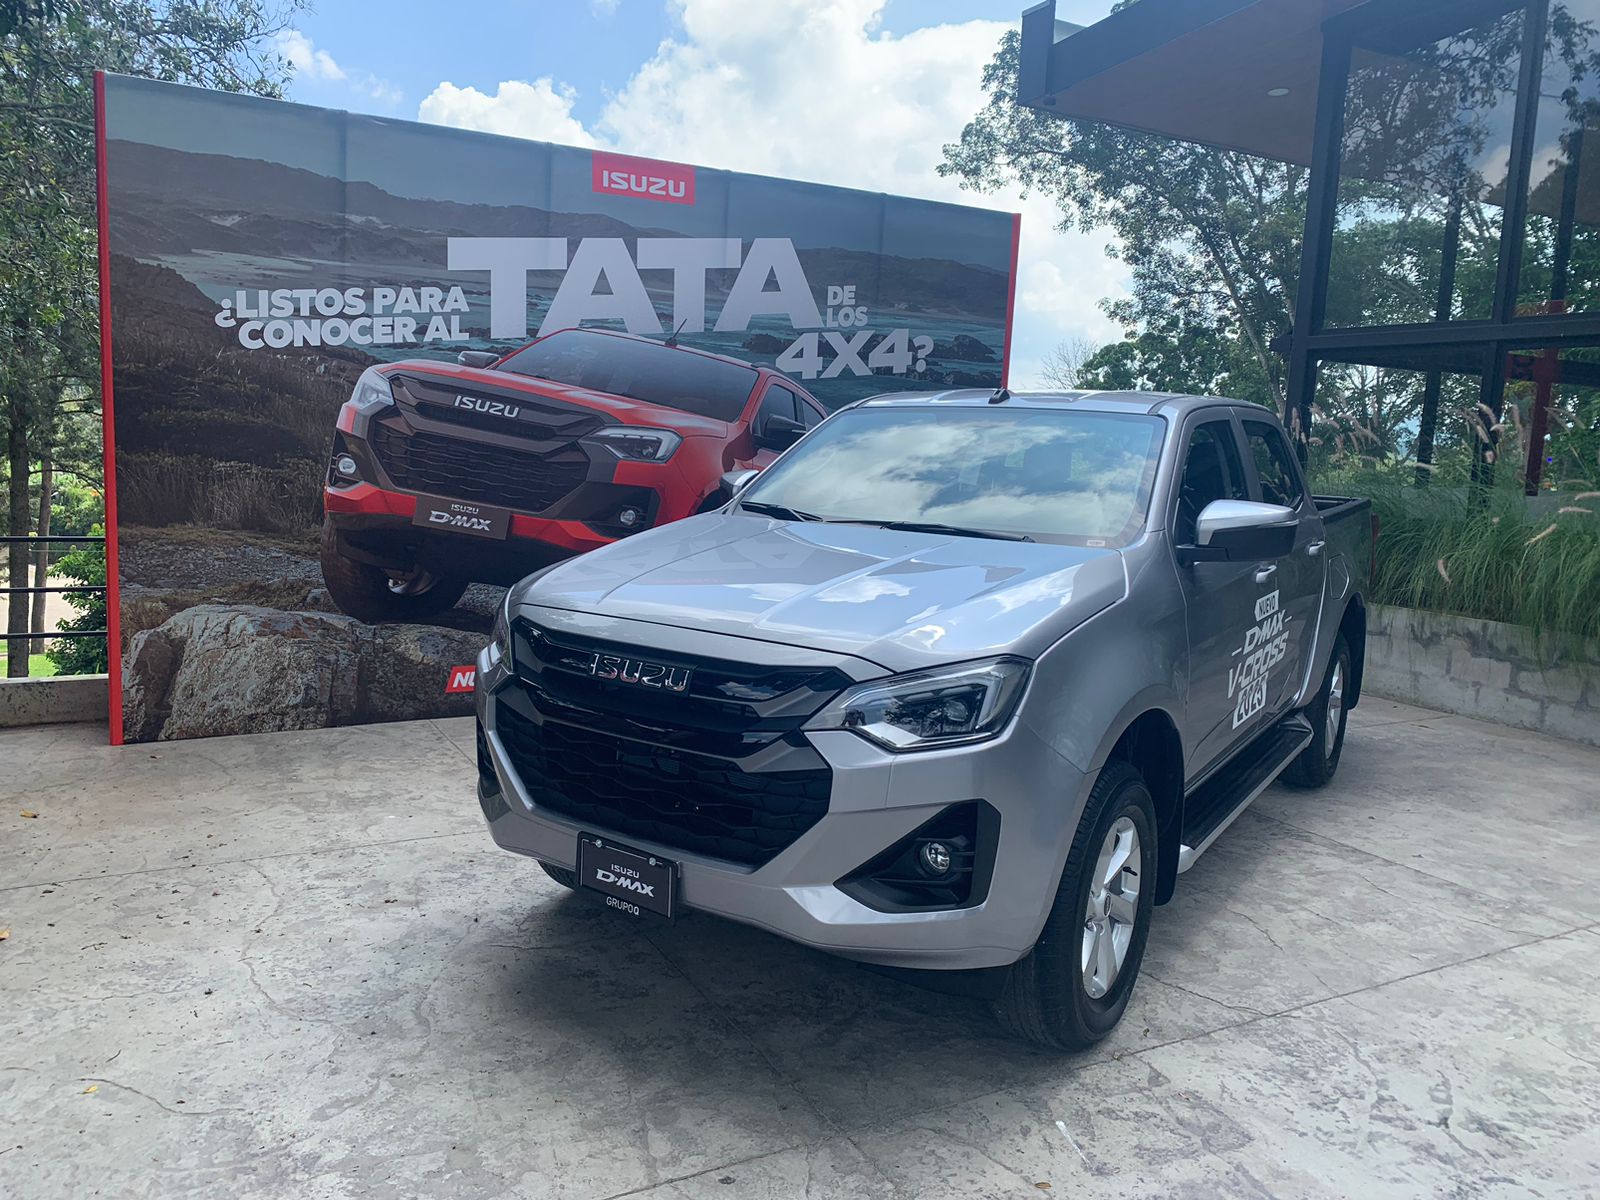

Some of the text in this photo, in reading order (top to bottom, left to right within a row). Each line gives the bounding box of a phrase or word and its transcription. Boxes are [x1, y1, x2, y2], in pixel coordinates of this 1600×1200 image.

[603, 170, 685, 197] ISUZU
[447, 237, 825, 339] TATA
[827, 285, 856, 306] DE
[215, 286, 470, 328] ¿LISTOS PARA
[826, 306, 868, 328] LOS
[238, 315, 470, 349] CONOCER AL
[775, 328, 935, 380] 4X4?
[454, 395, 519, 418] ISUZU
[451, 503, 479, 515] ISUZU
[590, 653, 690, 692] ISUZU
[611, 863, 640, 879] ISUZU
